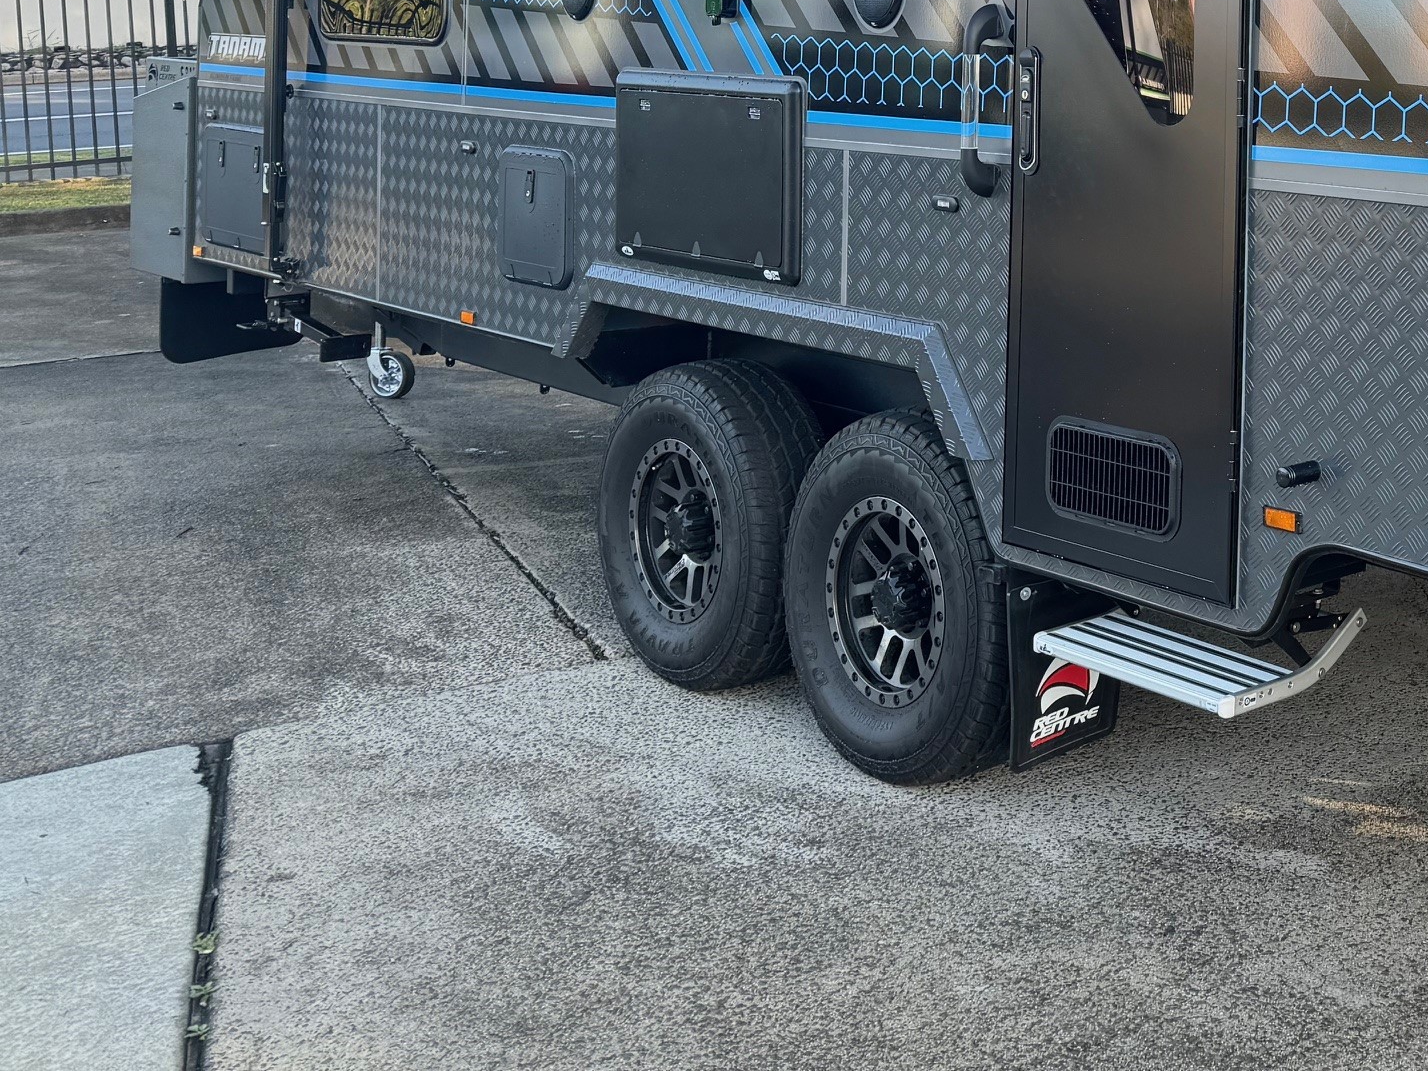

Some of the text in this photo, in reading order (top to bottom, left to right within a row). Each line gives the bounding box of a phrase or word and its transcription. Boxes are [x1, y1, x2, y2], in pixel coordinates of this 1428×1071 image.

[207, 33, 266, 63] TANAM
[1030, 706, 1099, 742] CENTRE
[1033, 707, 1069, 731] RED
